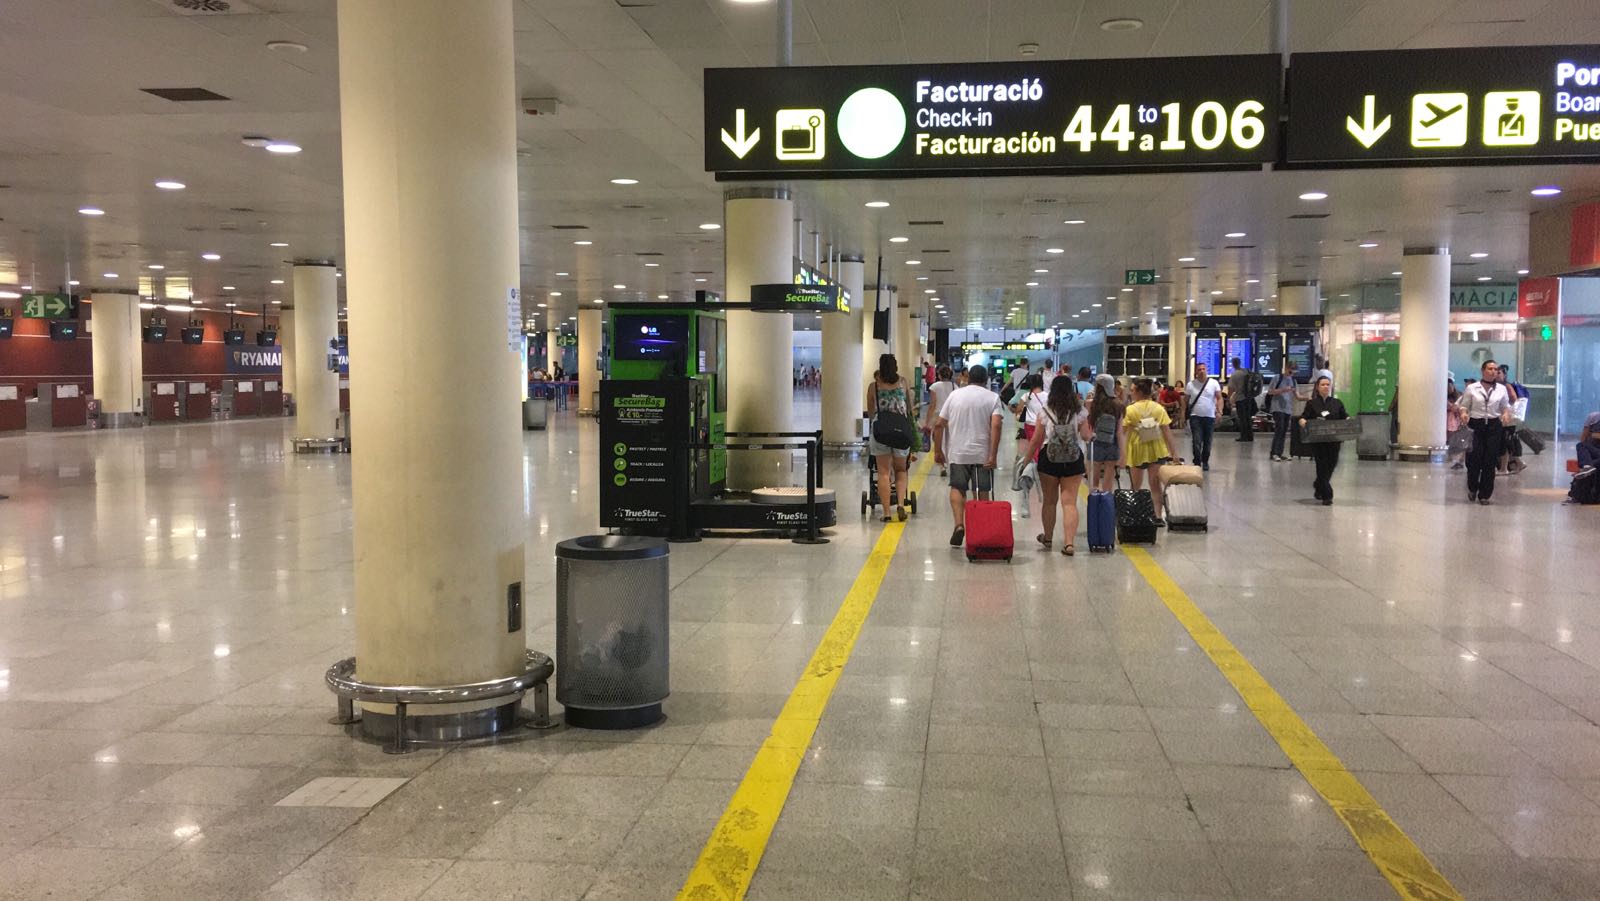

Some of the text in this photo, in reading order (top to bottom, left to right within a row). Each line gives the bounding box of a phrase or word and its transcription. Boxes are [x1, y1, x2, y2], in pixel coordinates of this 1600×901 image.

[916, 77, 1043, 103] Facturació
[916, 107, 993, 128] Check-in
[1062, 99, 1265, 152] 44 to 106
[1555, 117, 1600, 141] Pue
[915, 131, 1056, 155] Facturación
[1138, 133, 1155, 152] a
[785, 293, 830, 305] SecureBag
[618, 397, 662, 408] SecureBag
[624, 509, 660, 517] TrueStar
[776, 512, 808, 520] TrueSta
